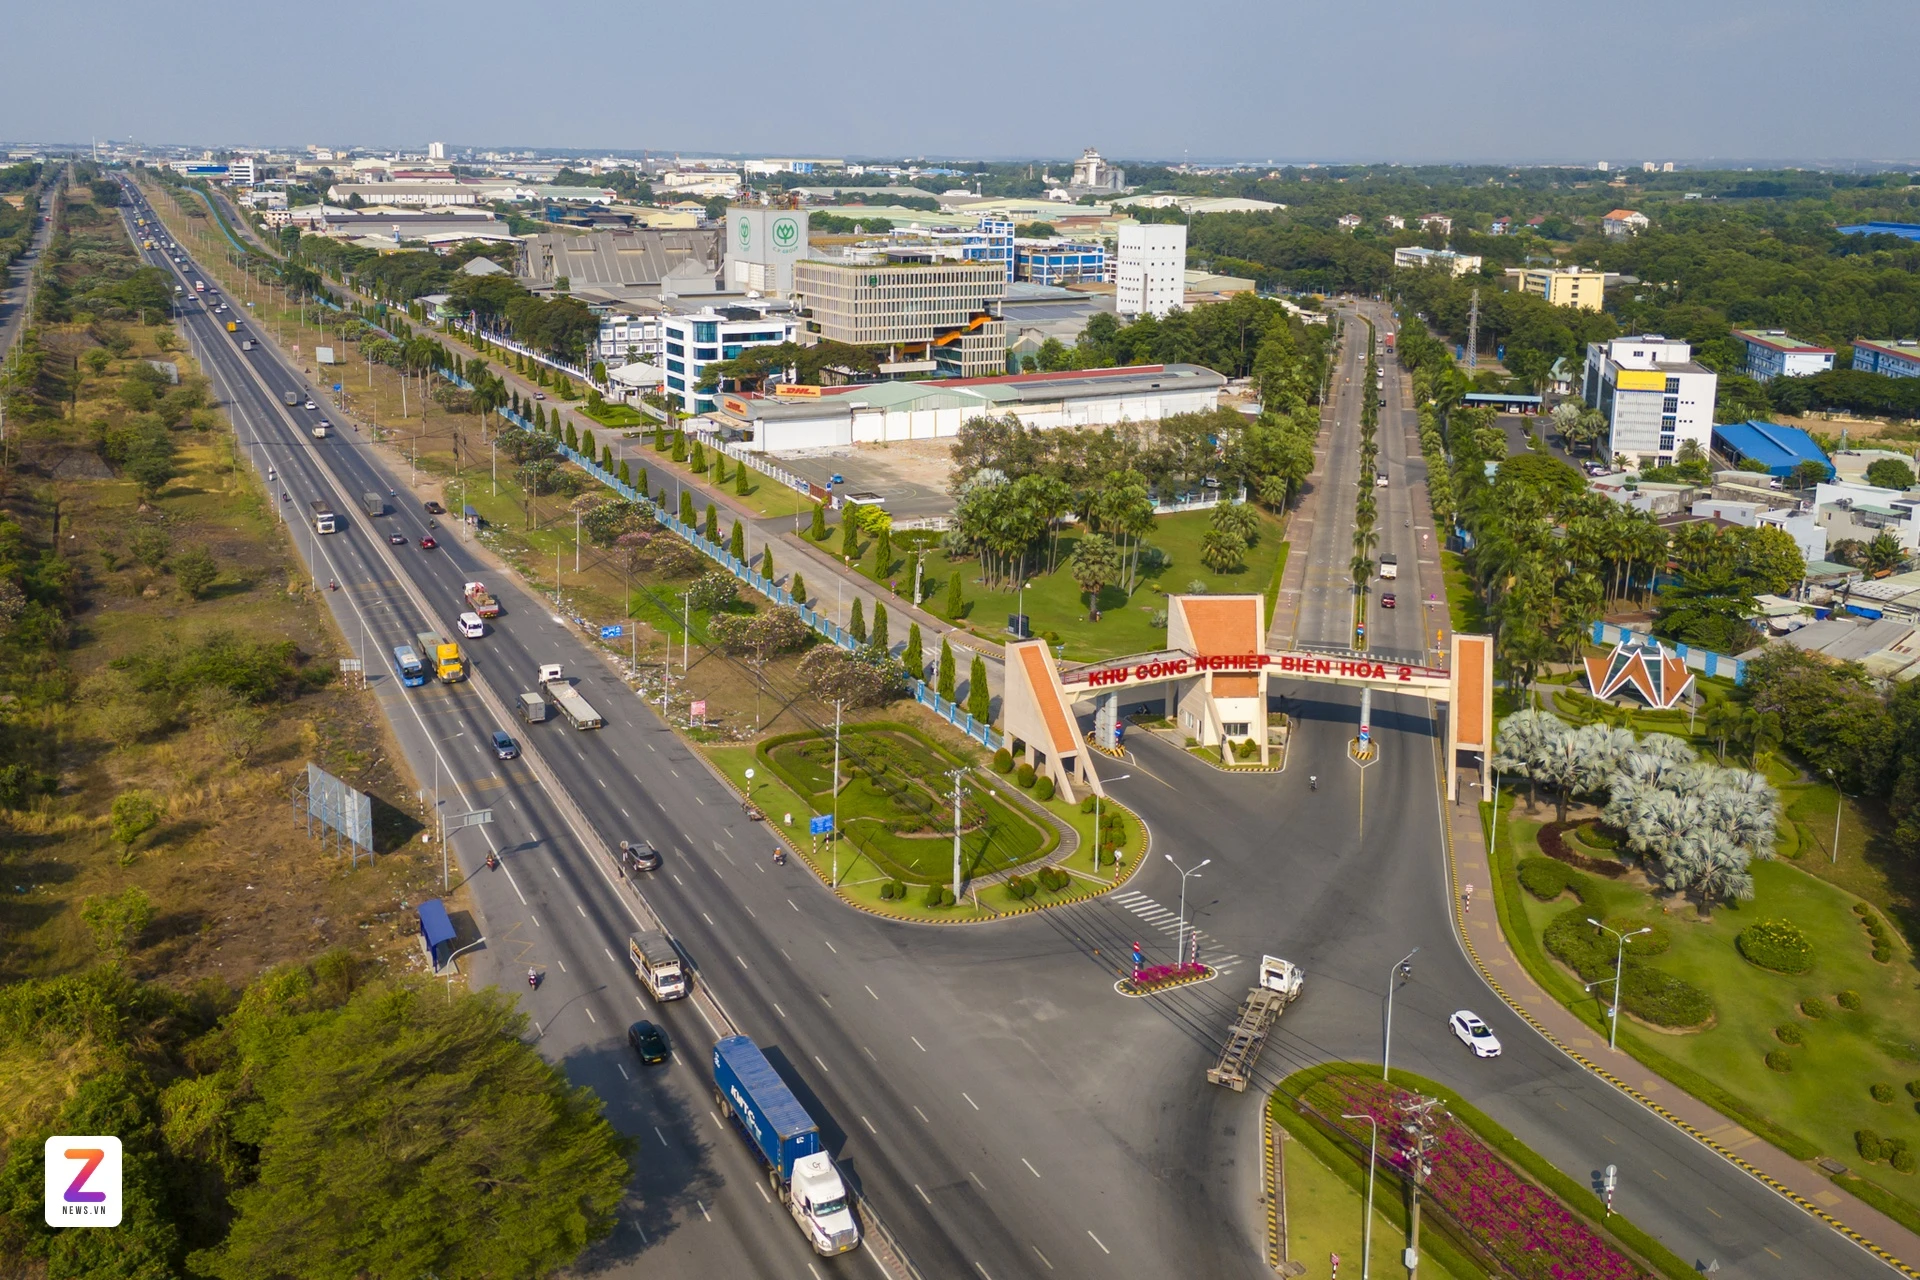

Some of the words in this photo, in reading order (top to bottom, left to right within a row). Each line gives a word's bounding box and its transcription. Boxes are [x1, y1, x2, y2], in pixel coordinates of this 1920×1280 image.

[784, 387, 811, 395] DHL
[1089, 668, 1128, 687] KHU
[1135, 657, 1188, 681] CÔNG
[1281, 653, 1331, 675] BIÊN
[1398, 666, 1412, 682] 2
